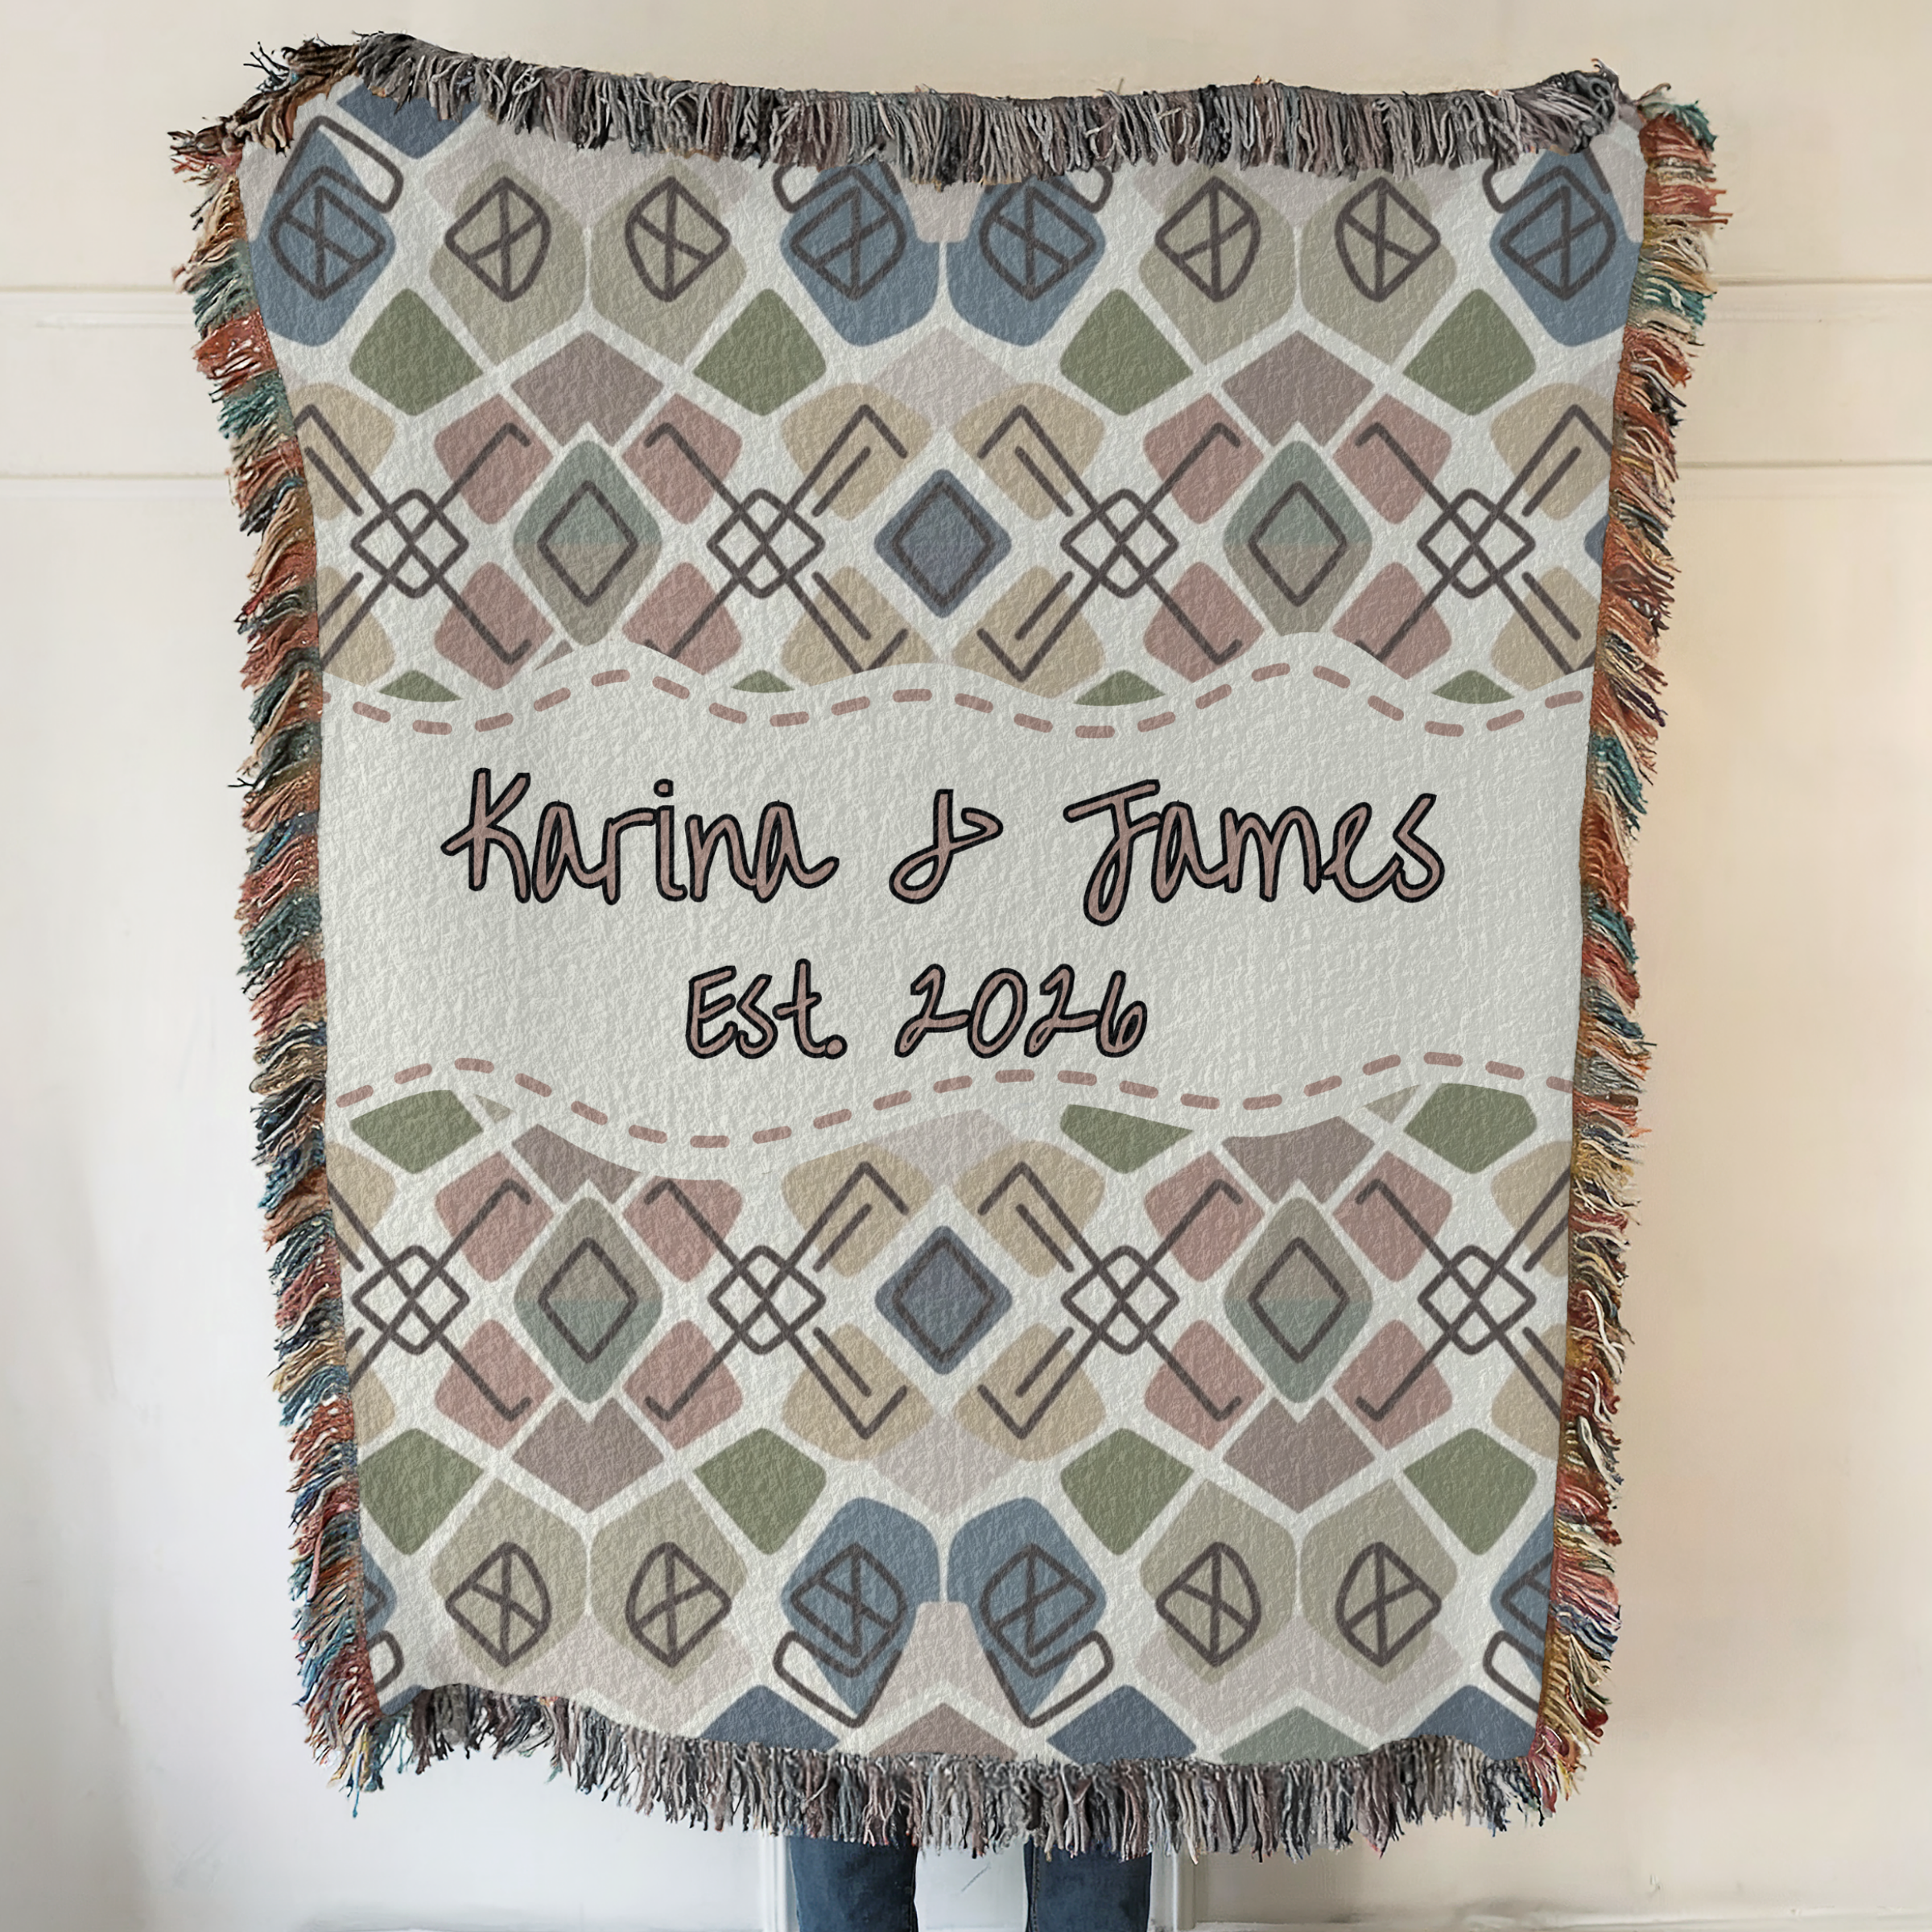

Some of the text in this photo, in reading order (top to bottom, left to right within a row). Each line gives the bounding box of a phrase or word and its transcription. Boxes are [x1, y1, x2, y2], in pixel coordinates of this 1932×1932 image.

[440, 767, 1445, 927] Karina & James
[685, 958, 1148, 1059] Est. 2026
